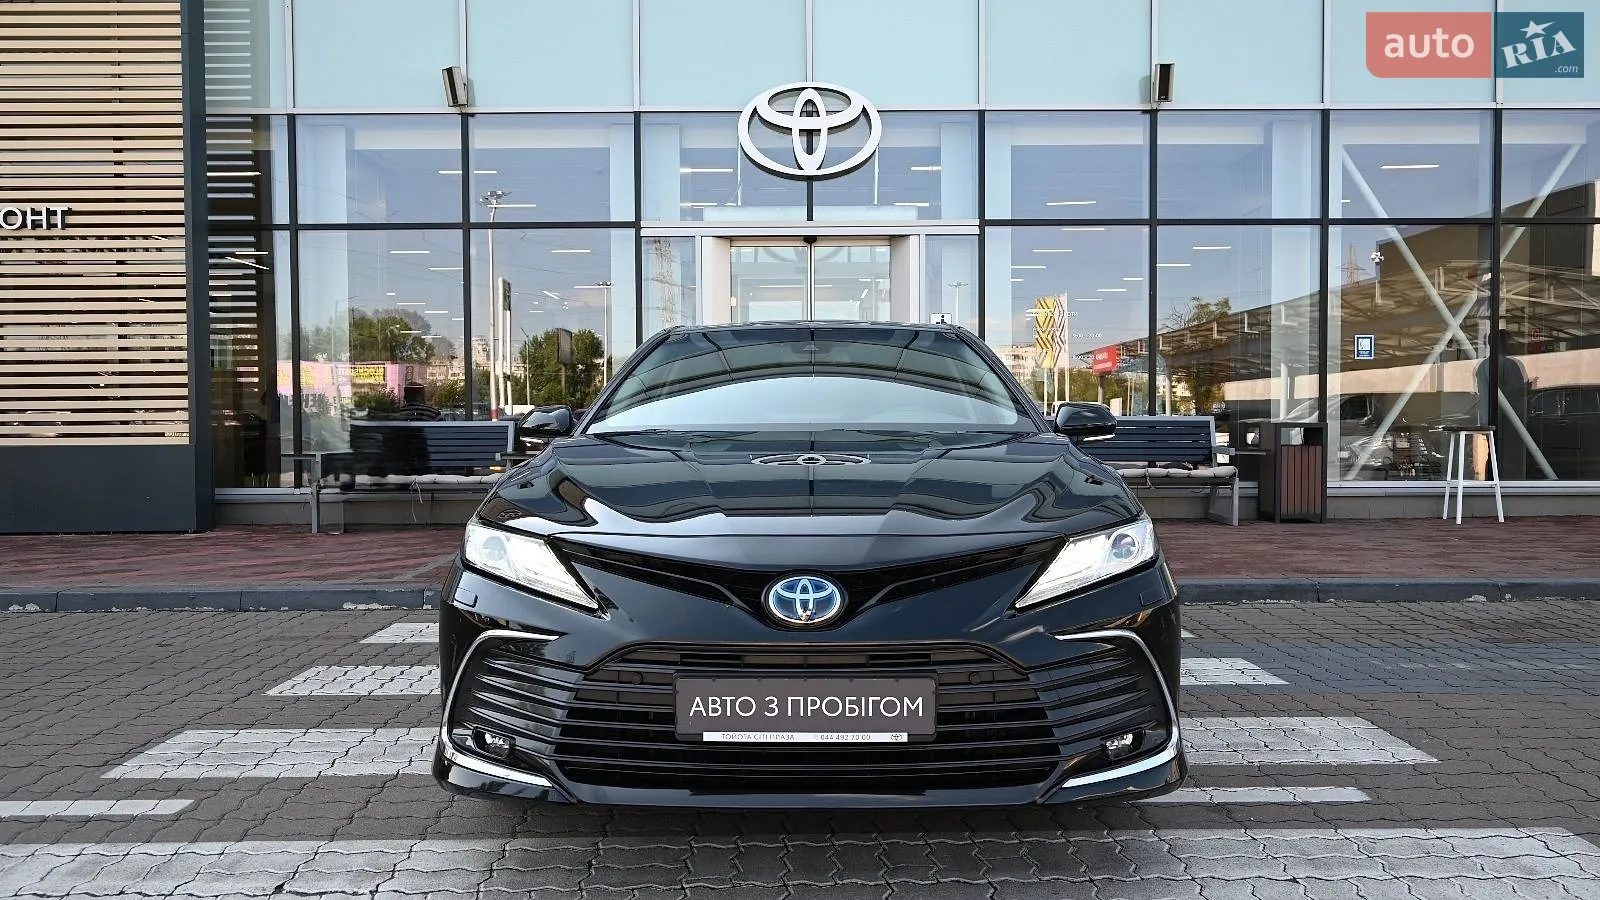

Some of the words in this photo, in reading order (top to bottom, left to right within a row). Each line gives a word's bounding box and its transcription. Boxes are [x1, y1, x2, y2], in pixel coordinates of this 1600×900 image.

[0, 206, 70, 230] ОНТ
[689, 696, 756, 718] АВТО
[787, 696, 923, 718] ПРОБІГОМ
[722, 732, 752, 741] ТОЙОТА
